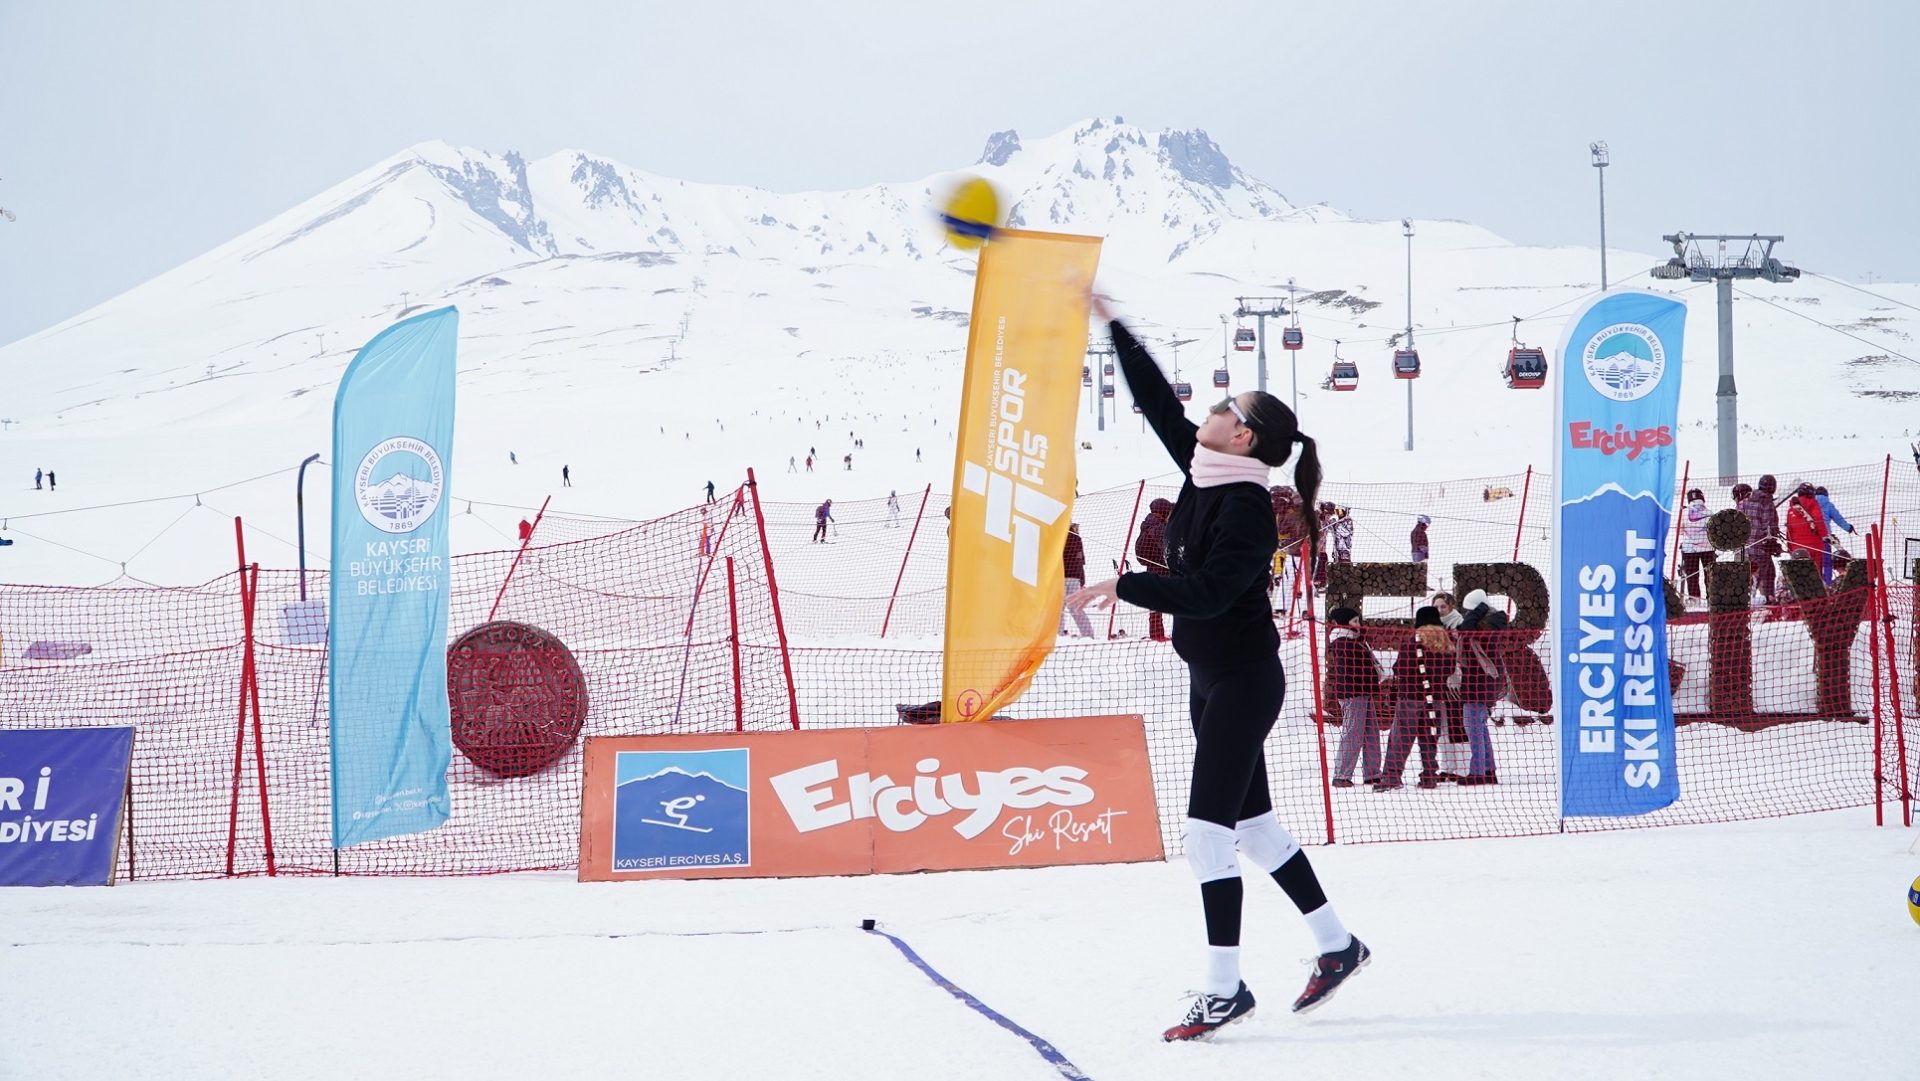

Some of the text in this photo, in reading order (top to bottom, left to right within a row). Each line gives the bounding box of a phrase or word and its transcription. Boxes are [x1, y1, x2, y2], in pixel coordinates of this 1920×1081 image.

[1613, 391, 1634, 399] 1869
[994, 367, 1027, 475] SPOR
[1569, 421, 1674, 462] Erciyes
[390, 521, 414, 530] 1869
[350, 555, 442, 577] BÜYÜKŞEHR
[1568, 564, 1616, 753] ERCİYES
[1624, 529, 1661, 789] SKI RESORT
[768, 757, 1096, 840] Erciyes
[0, 813, 98, 843] DİYESİ
[1002, 807, 1128, 856] Ski Resort
[616, 852, 745, 868] KAYSERİ ERCİYES A.Ş.
